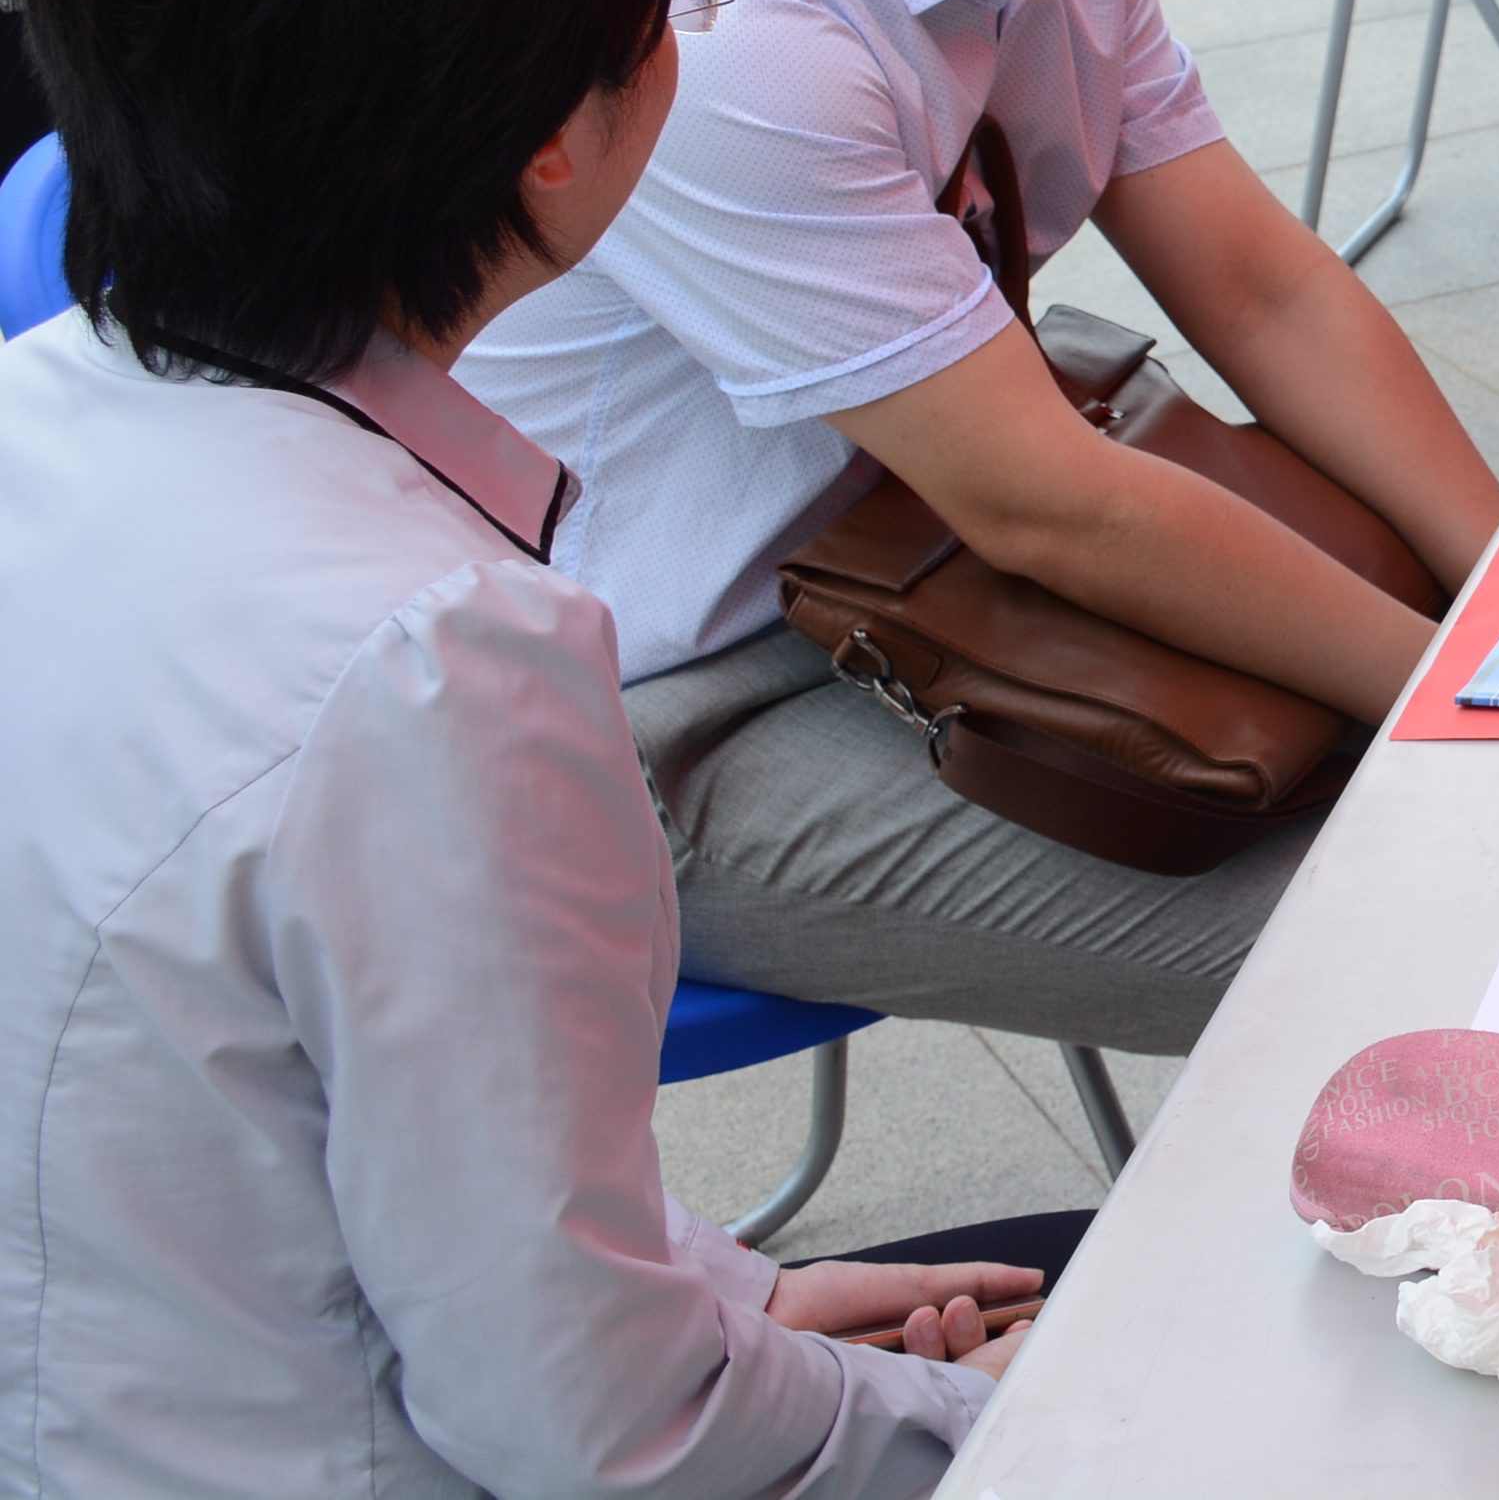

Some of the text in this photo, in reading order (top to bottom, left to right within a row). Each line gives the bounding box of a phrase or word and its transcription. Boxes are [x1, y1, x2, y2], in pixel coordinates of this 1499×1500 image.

[1324, 1058, 1399, 1103] NICE
[1322, 1087, 1375, 1122] TOP
[1323, 1092, 1428, 1140] FASHION
